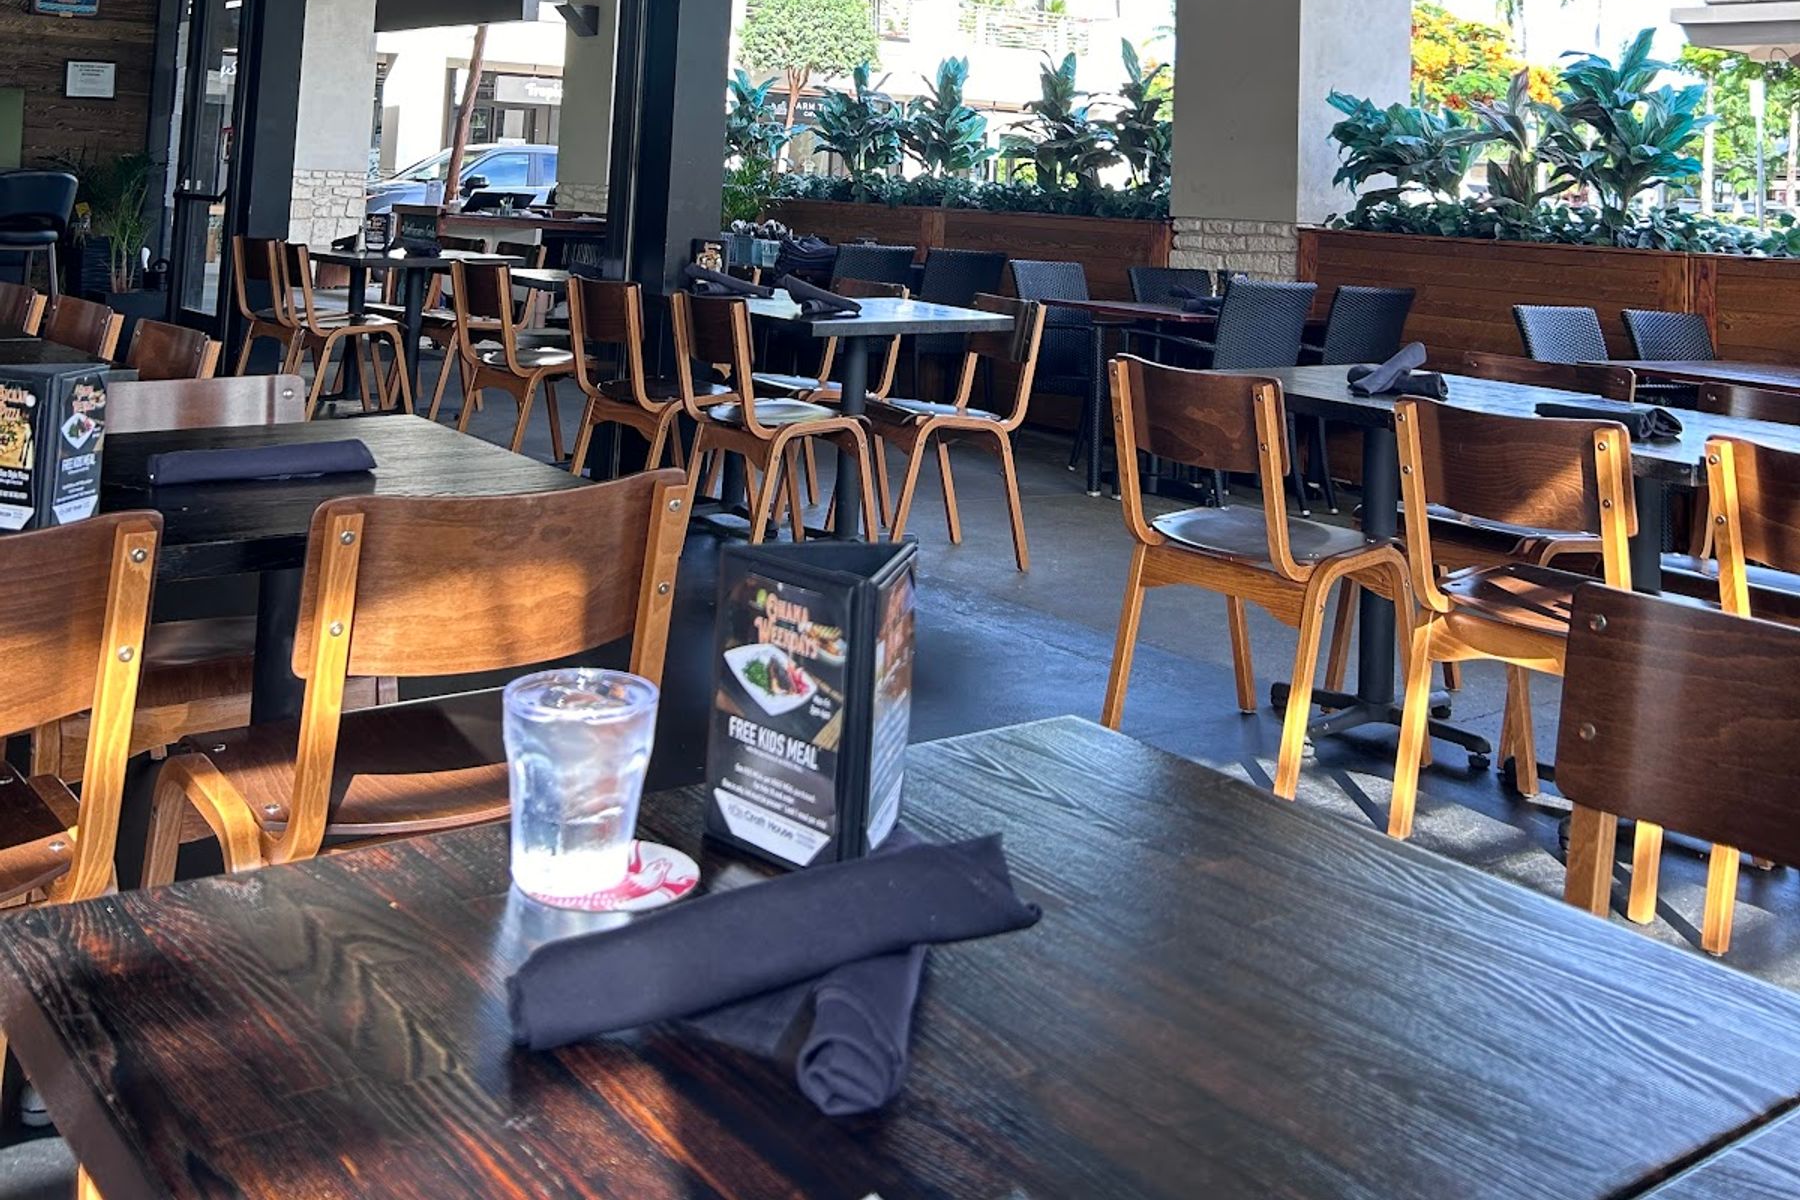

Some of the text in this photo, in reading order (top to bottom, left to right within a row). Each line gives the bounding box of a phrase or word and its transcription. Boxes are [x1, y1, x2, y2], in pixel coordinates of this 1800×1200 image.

[795, 102, 815, 111] ARM
[728, 715, 758, 746] FREE
[757, 726, 786, 756] KIDS
[786, 737, 819, 771] MEAL
